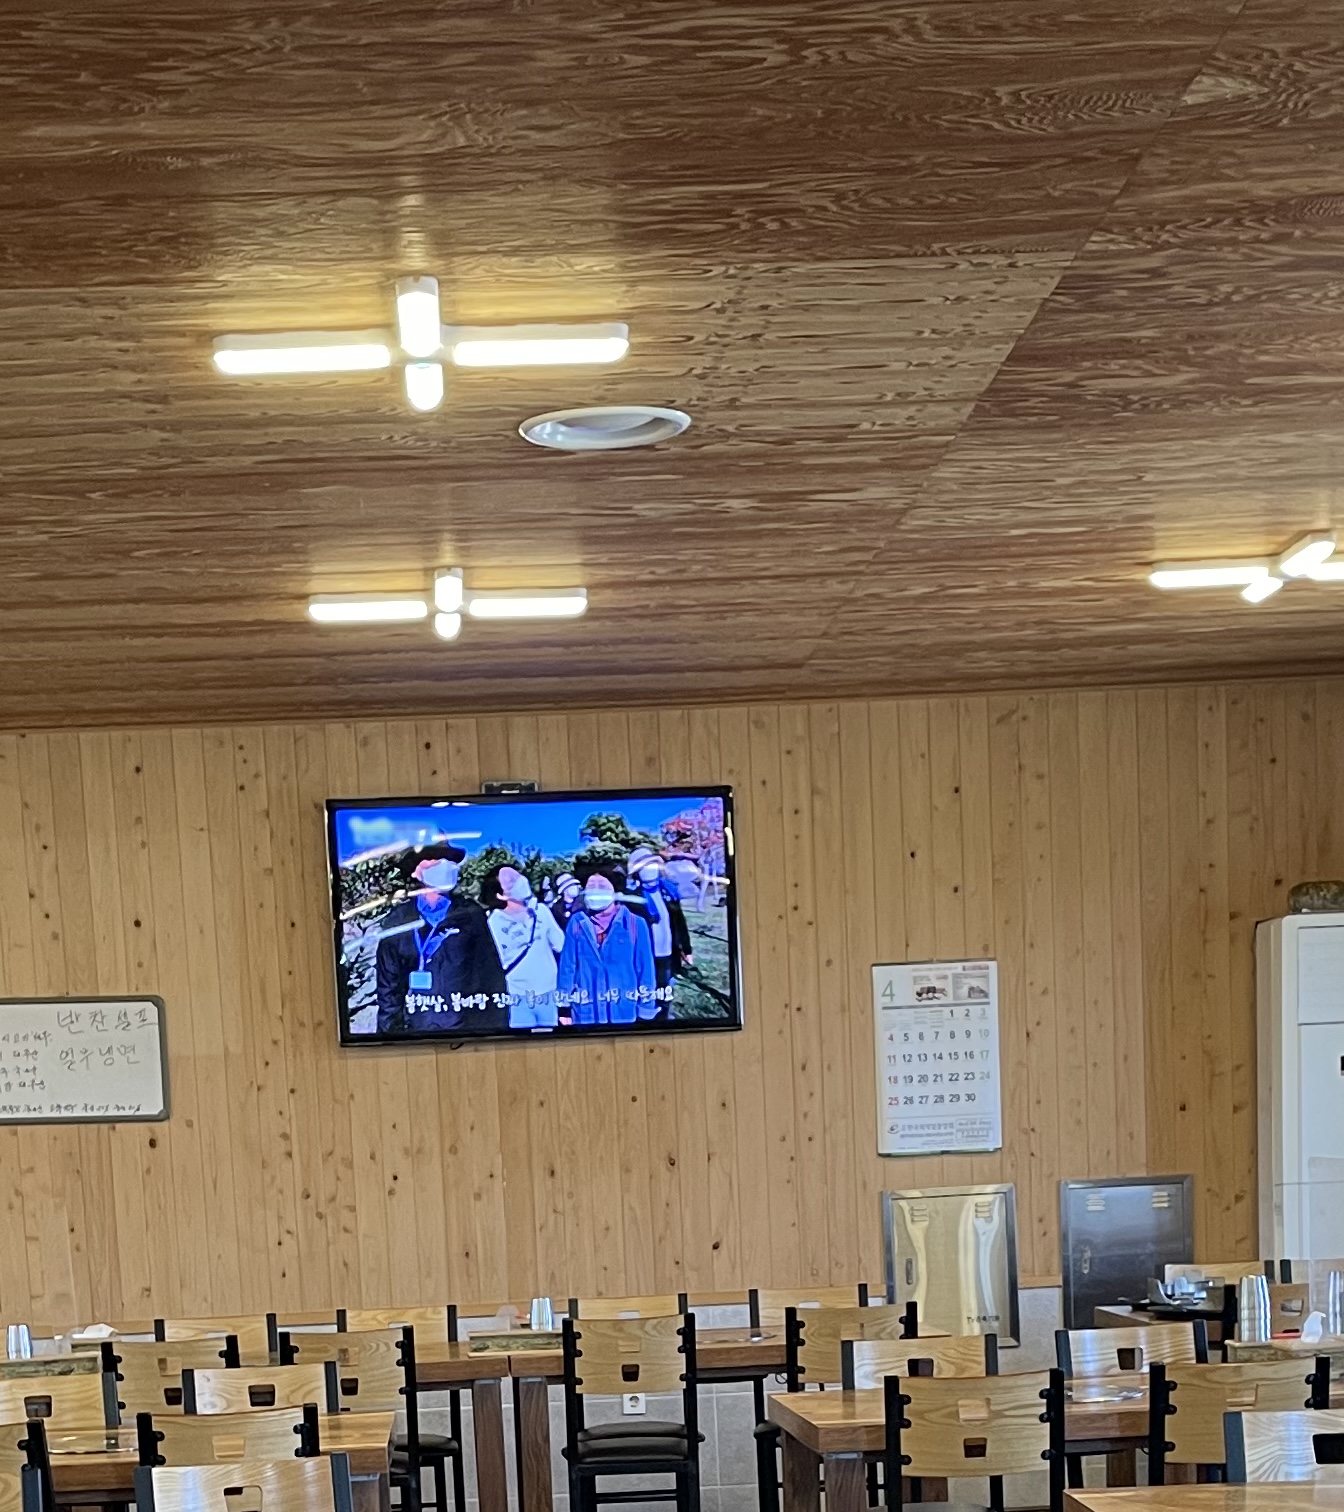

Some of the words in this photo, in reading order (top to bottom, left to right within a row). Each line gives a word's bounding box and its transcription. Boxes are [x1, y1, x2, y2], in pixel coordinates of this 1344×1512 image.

[881, 980, 895, 1001] 4
[451, 992, 489, 1010] 봄바람
[598, 989, 619, 1003] 너무
[949, 1009, 954, 1018] 1
[964, 1009, 970, 1017] 2
[980, 1008, 986, 1016] 3
[888, 1033, 894, 1042] 4
[904, 1033, 909, 1041] 5
[918, 1032, 924, 1041] 6
[934, 1031, 939, 1040] 7
[949, 1030, 955, 1039] 8
[965, 1030, 971, 1038] 9
[979, 1029, 989, 1038] 10
[887, 1055, 896, 1064] 11
[903, 1054, 913, 1063] 12
[918, 1053, 928, 1062] 13
[933, 1052, 944, 1061] 14
[948, 1052, 959, 1060] 15
[964, 1051, 974, 1060] 16
[979, 1050, 989, 1060] 17
[888, 1076, 898, 1084] 18
[903, 1075, 914, 1084] 19
[918, 1074, 928, 1083] 20
[933, 1074, 944, 1082] 21
[948, 1073, 960, 1082] 22
[964, 1072, 975, 1081] 23
[979, 1071, 990, 1080] 24
[888, 1097, 899, 1106] 25
[904, 1096, 914, 1105] 26
[918, 1096, 929, 1104] 27
[934, 1095, 944, 1103] 28
[949, 1093, 960, 1102] 29
[965, 1093, 976, 1102] 30
